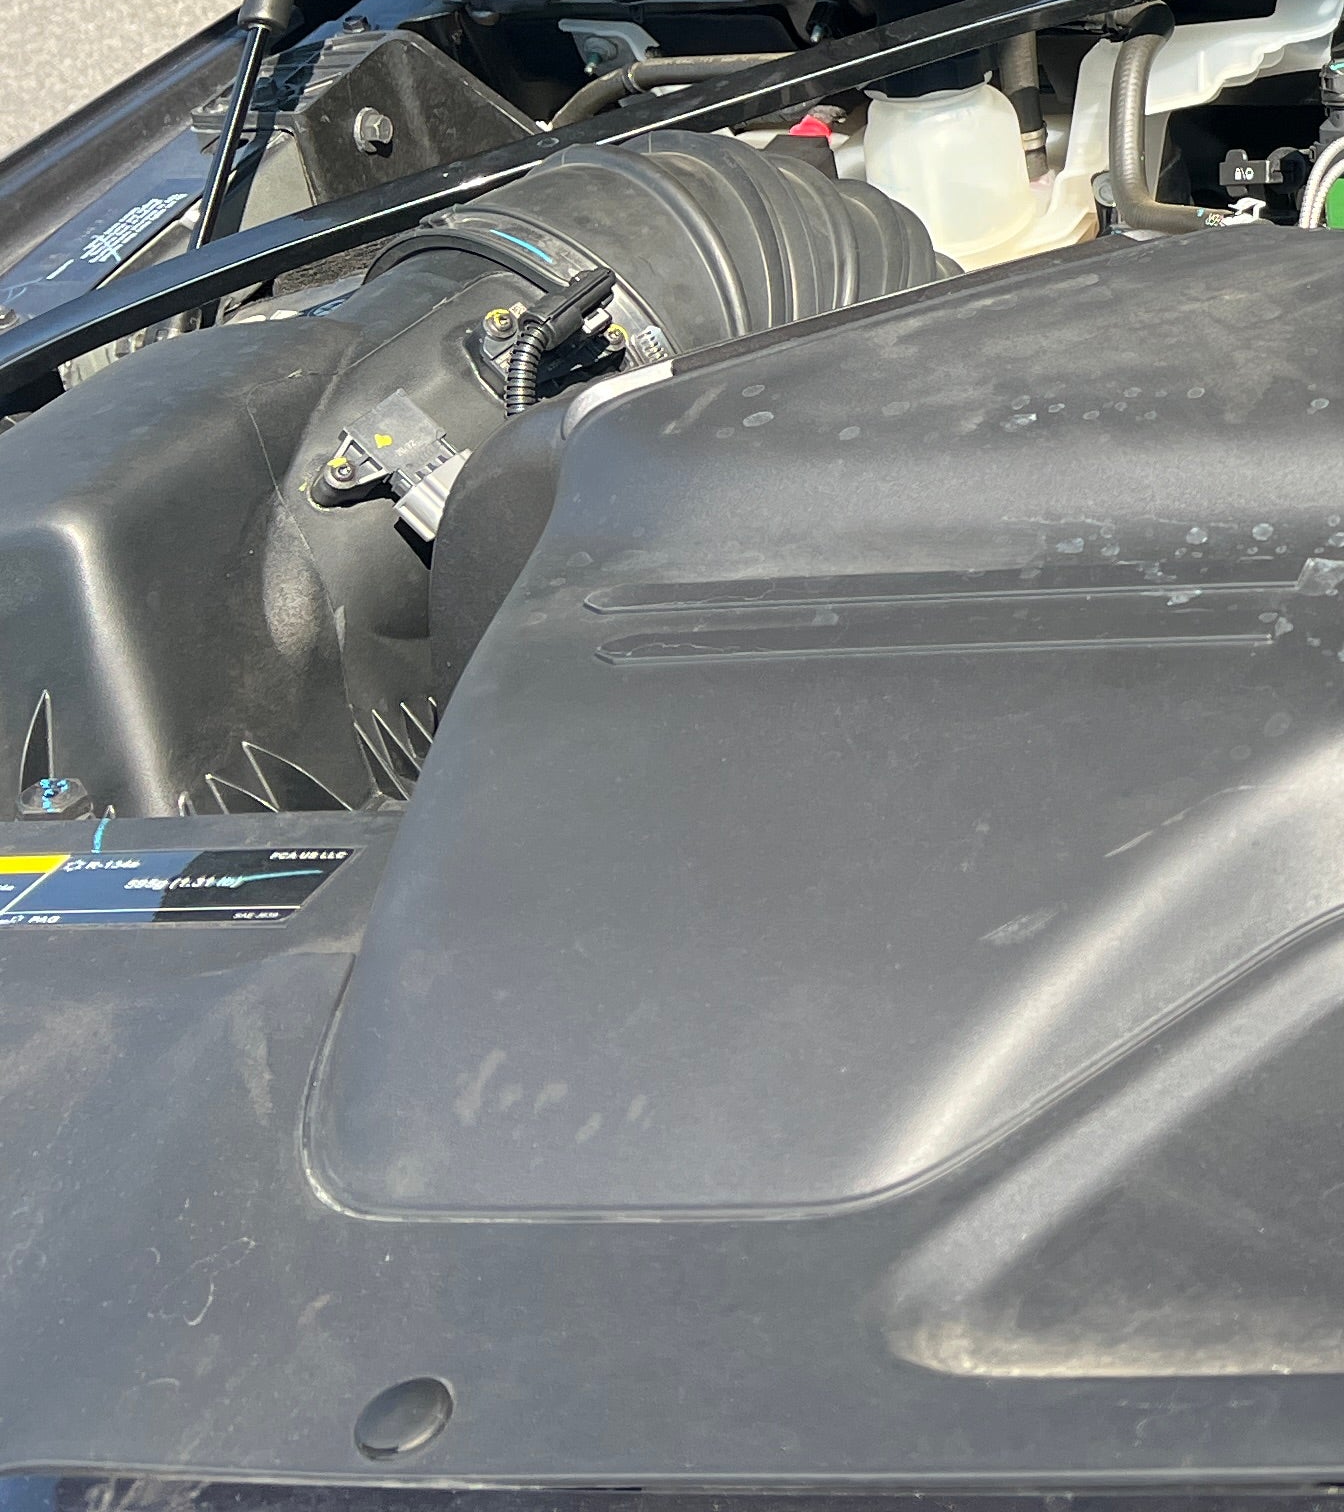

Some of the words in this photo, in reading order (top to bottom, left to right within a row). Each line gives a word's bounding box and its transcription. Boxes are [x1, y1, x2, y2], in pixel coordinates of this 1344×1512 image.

[269, 851, 297, 860] FCA
[299, 851, 319, 859] US
[320, 850, 348, 859] LLC
[85, 858, 142, 870] R-134a
